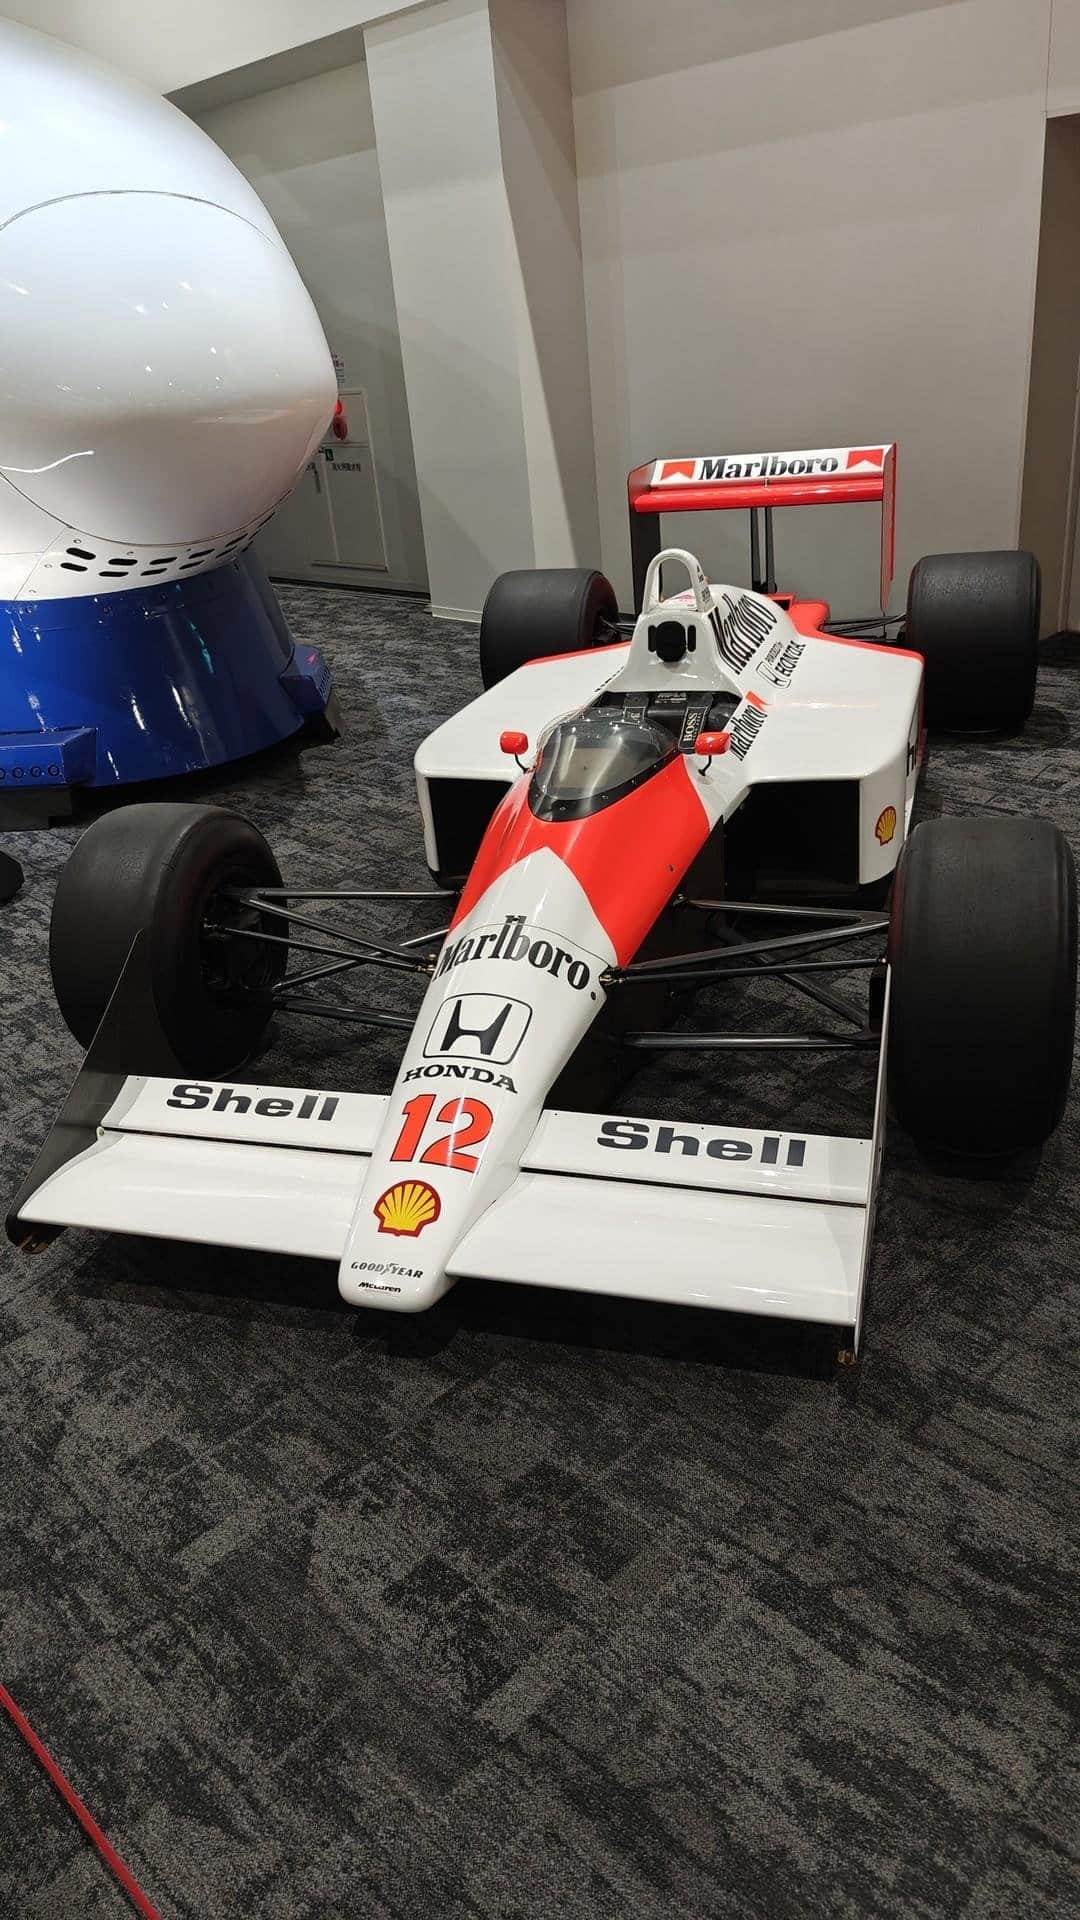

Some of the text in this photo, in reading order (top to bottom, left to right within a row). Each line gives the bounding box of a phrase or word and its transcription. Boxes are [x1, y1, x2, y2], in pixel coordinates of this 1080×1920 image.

[699, 455, 838, 481] Marlboro
[708, 593, 778, 675] Marlboro
[775, 640, 806, 677] HONDA
[683, 712, 698, 742] BOSS
[432, 915, 590, 990] Marlboro
[402, 1064, 518, 1094] HONDA
[166, 1084, 340, 1122] Shell
[390, 1093, 494, 1173] 12
[597, 1120, 806, 1167] Shell
